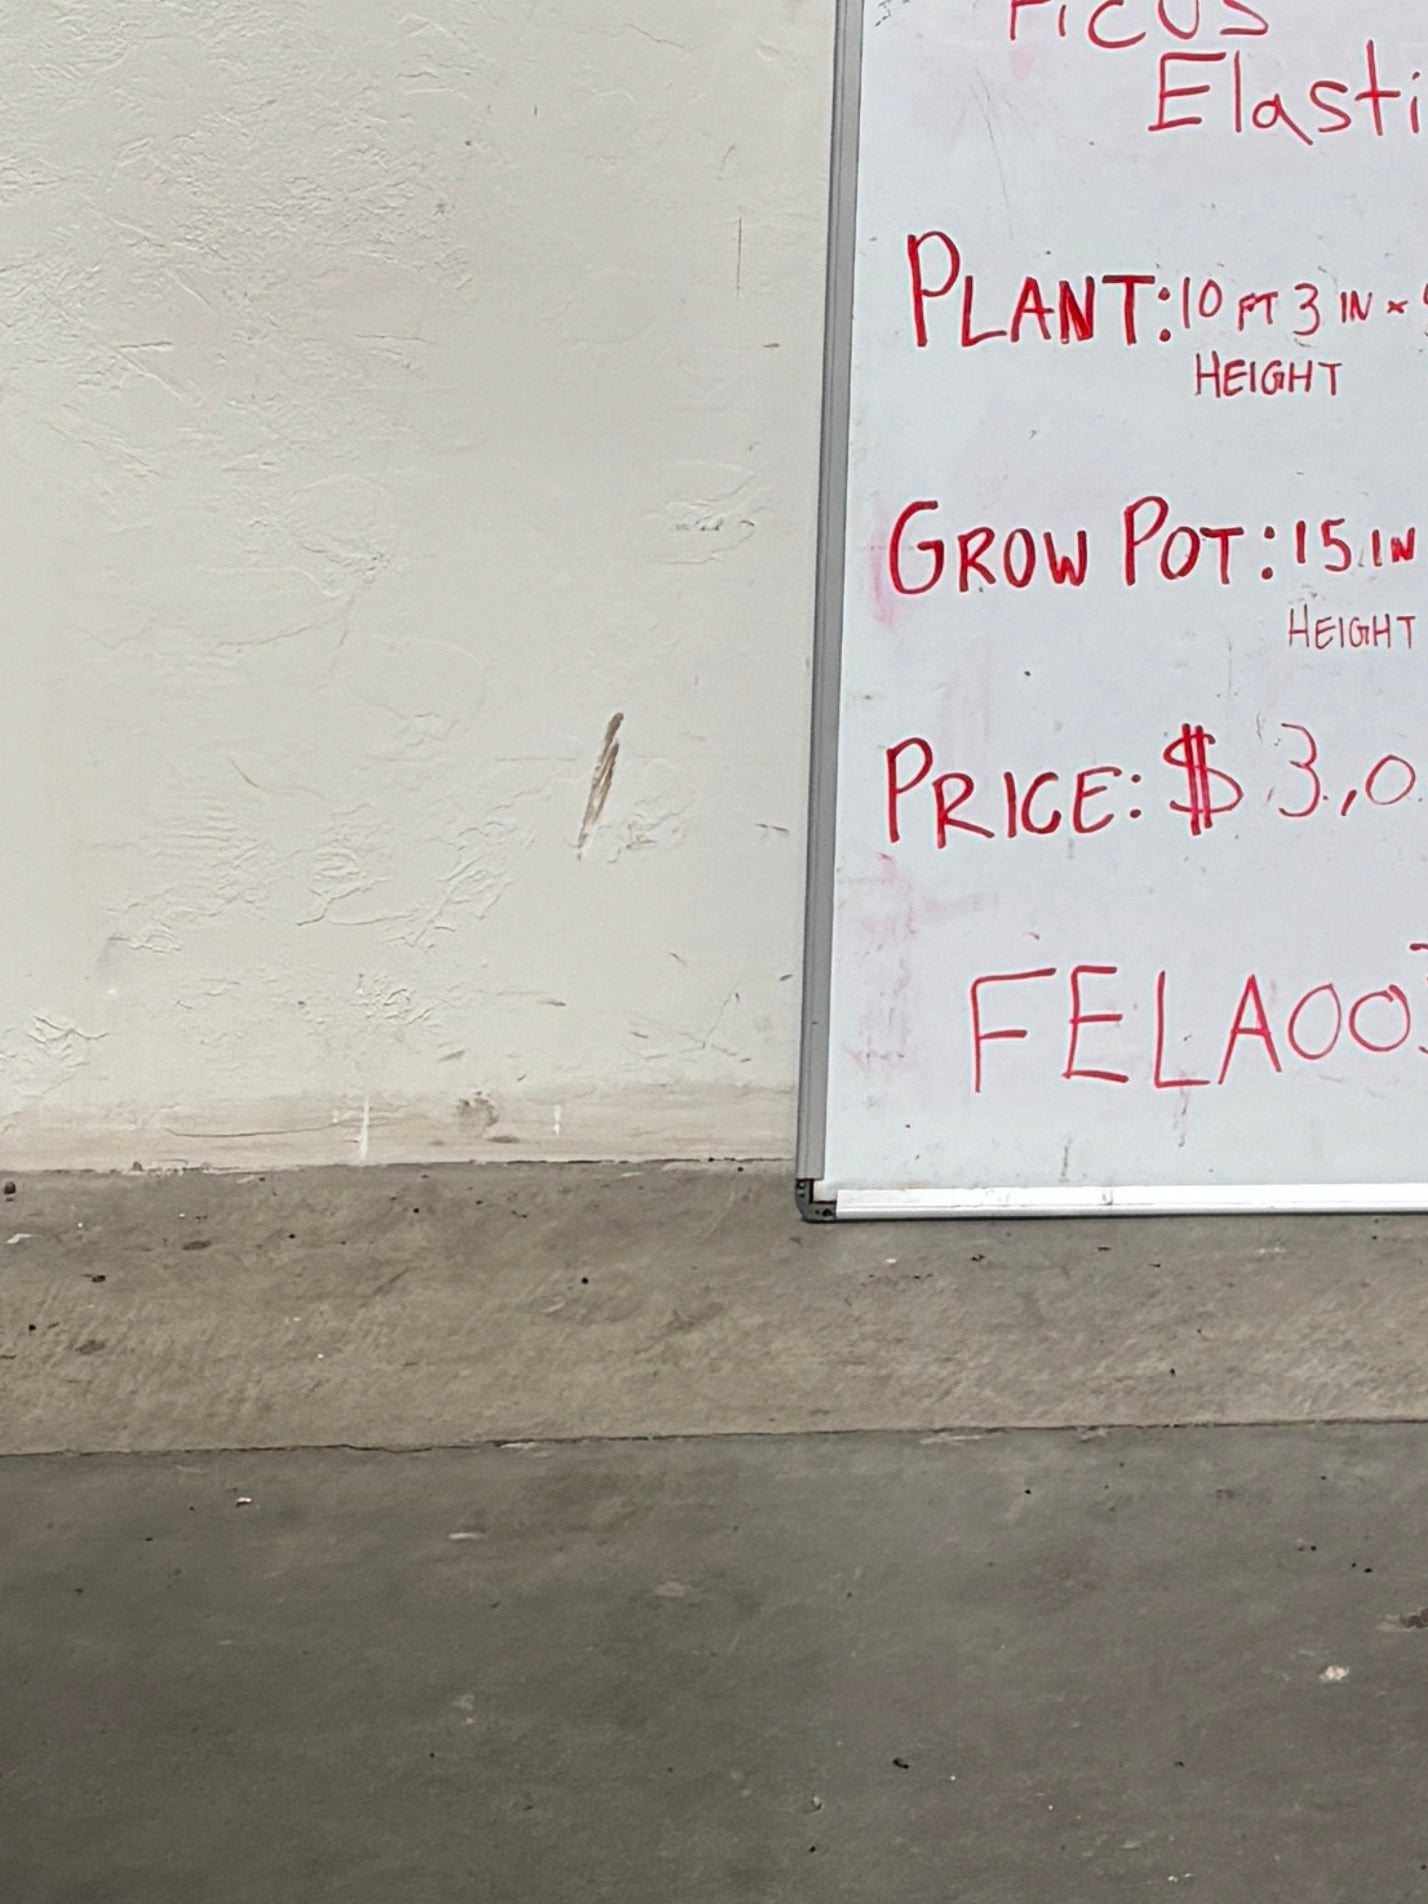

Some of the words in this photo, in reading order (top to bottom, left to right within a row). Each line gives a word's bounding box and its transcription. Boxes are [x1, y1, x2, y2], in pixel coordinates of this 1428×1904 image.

[1181, 279, 1223, 325] 10
[1237, 292, 1279, 332] FT
[1294, 283, 1321, 337] 3
[1340, 291, 1373, 324] IN
[1195, 350, 1344, 398] HEIGHT
[887, 500, 1088, 596] GROW
[1295, 518, 1353, 573] 15
[1288, 603, 1417, 650] HEIGHT
